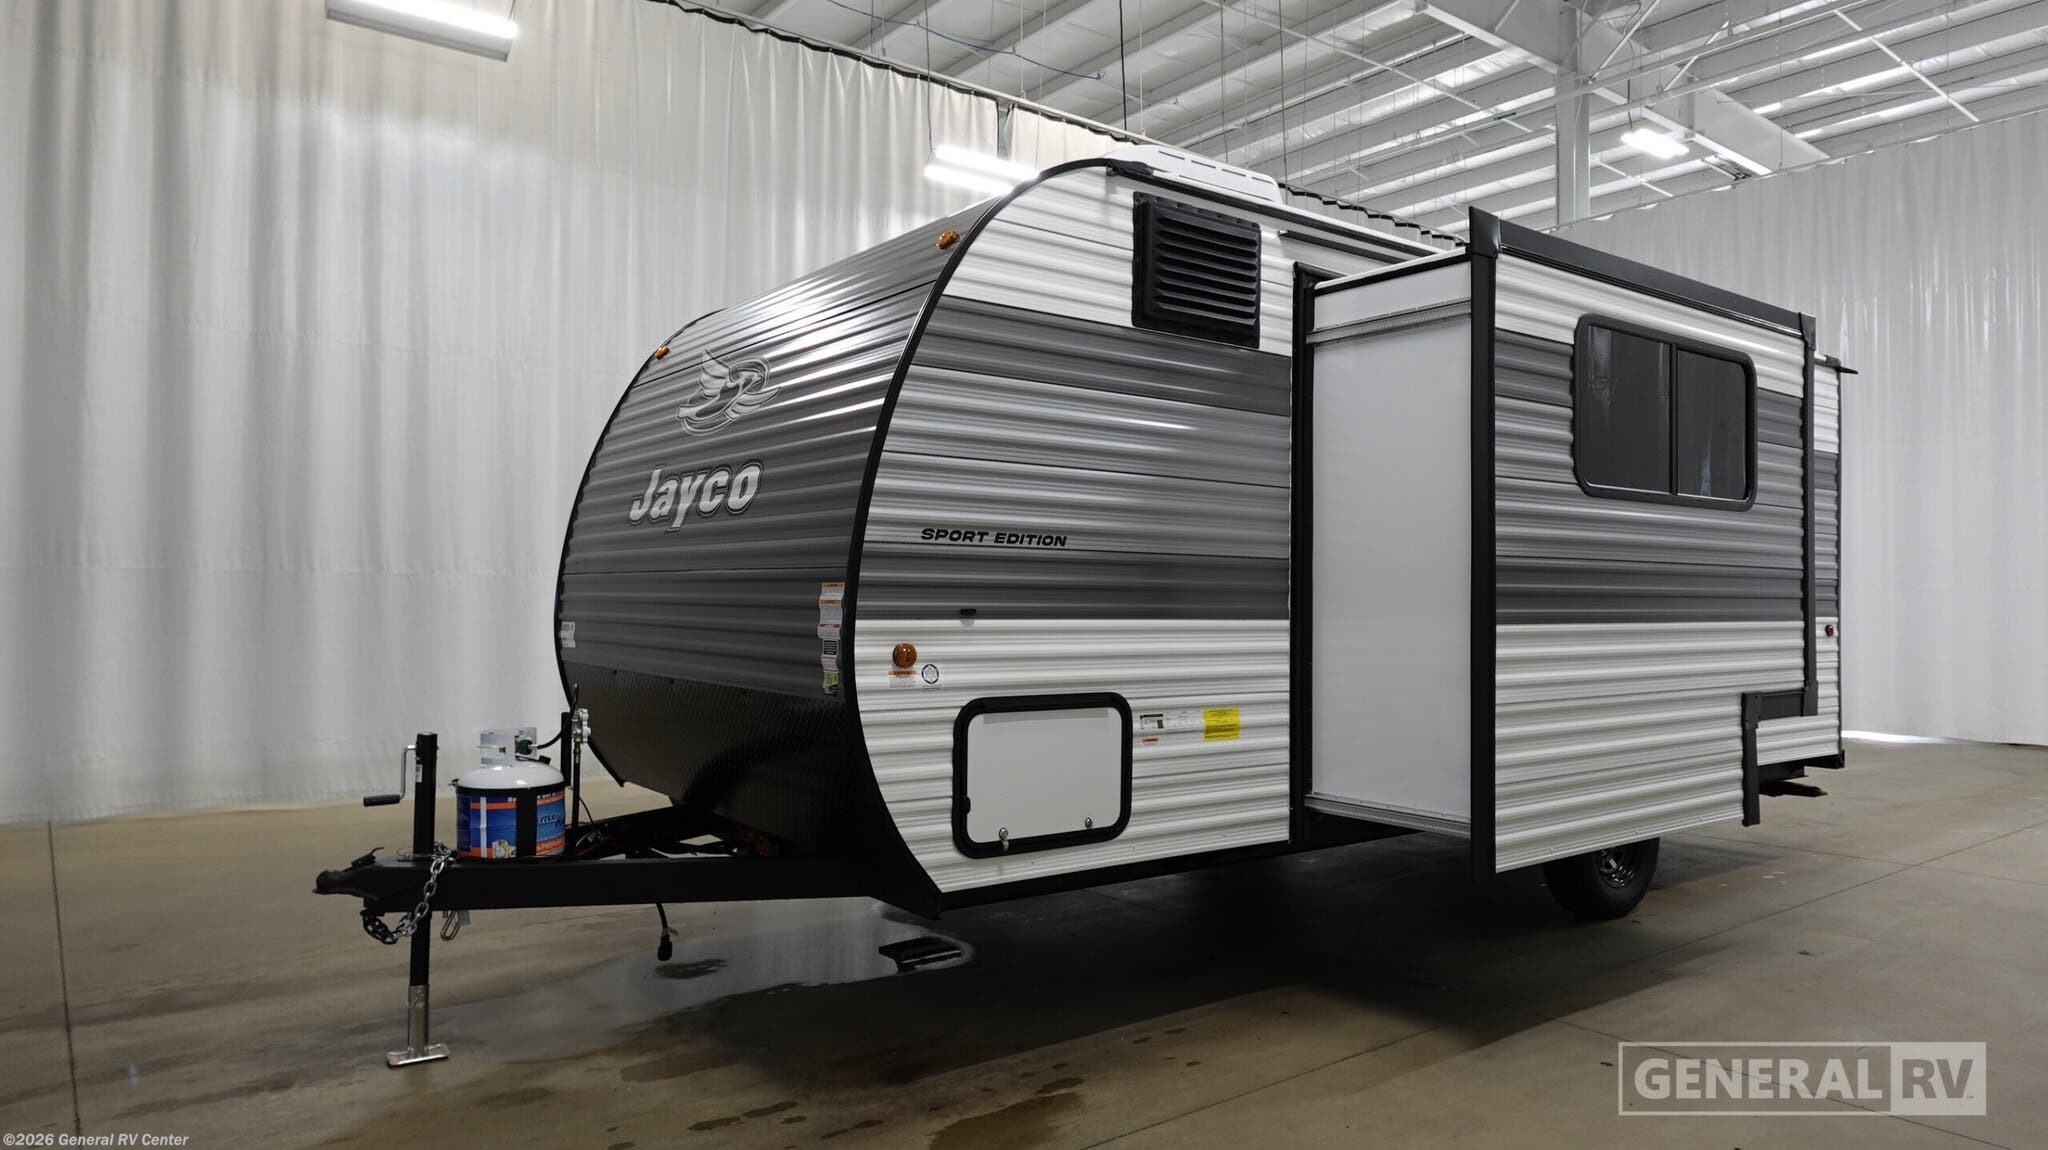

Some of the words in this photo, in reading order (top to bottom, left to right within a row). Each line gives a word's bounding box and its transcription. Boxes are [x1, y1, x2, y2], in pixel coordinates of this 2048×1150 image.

[628, 461, 764, 533] Jayco
[921, 528, 989, 543] SPORT
[994, 532, 1067, 547] EDITION
